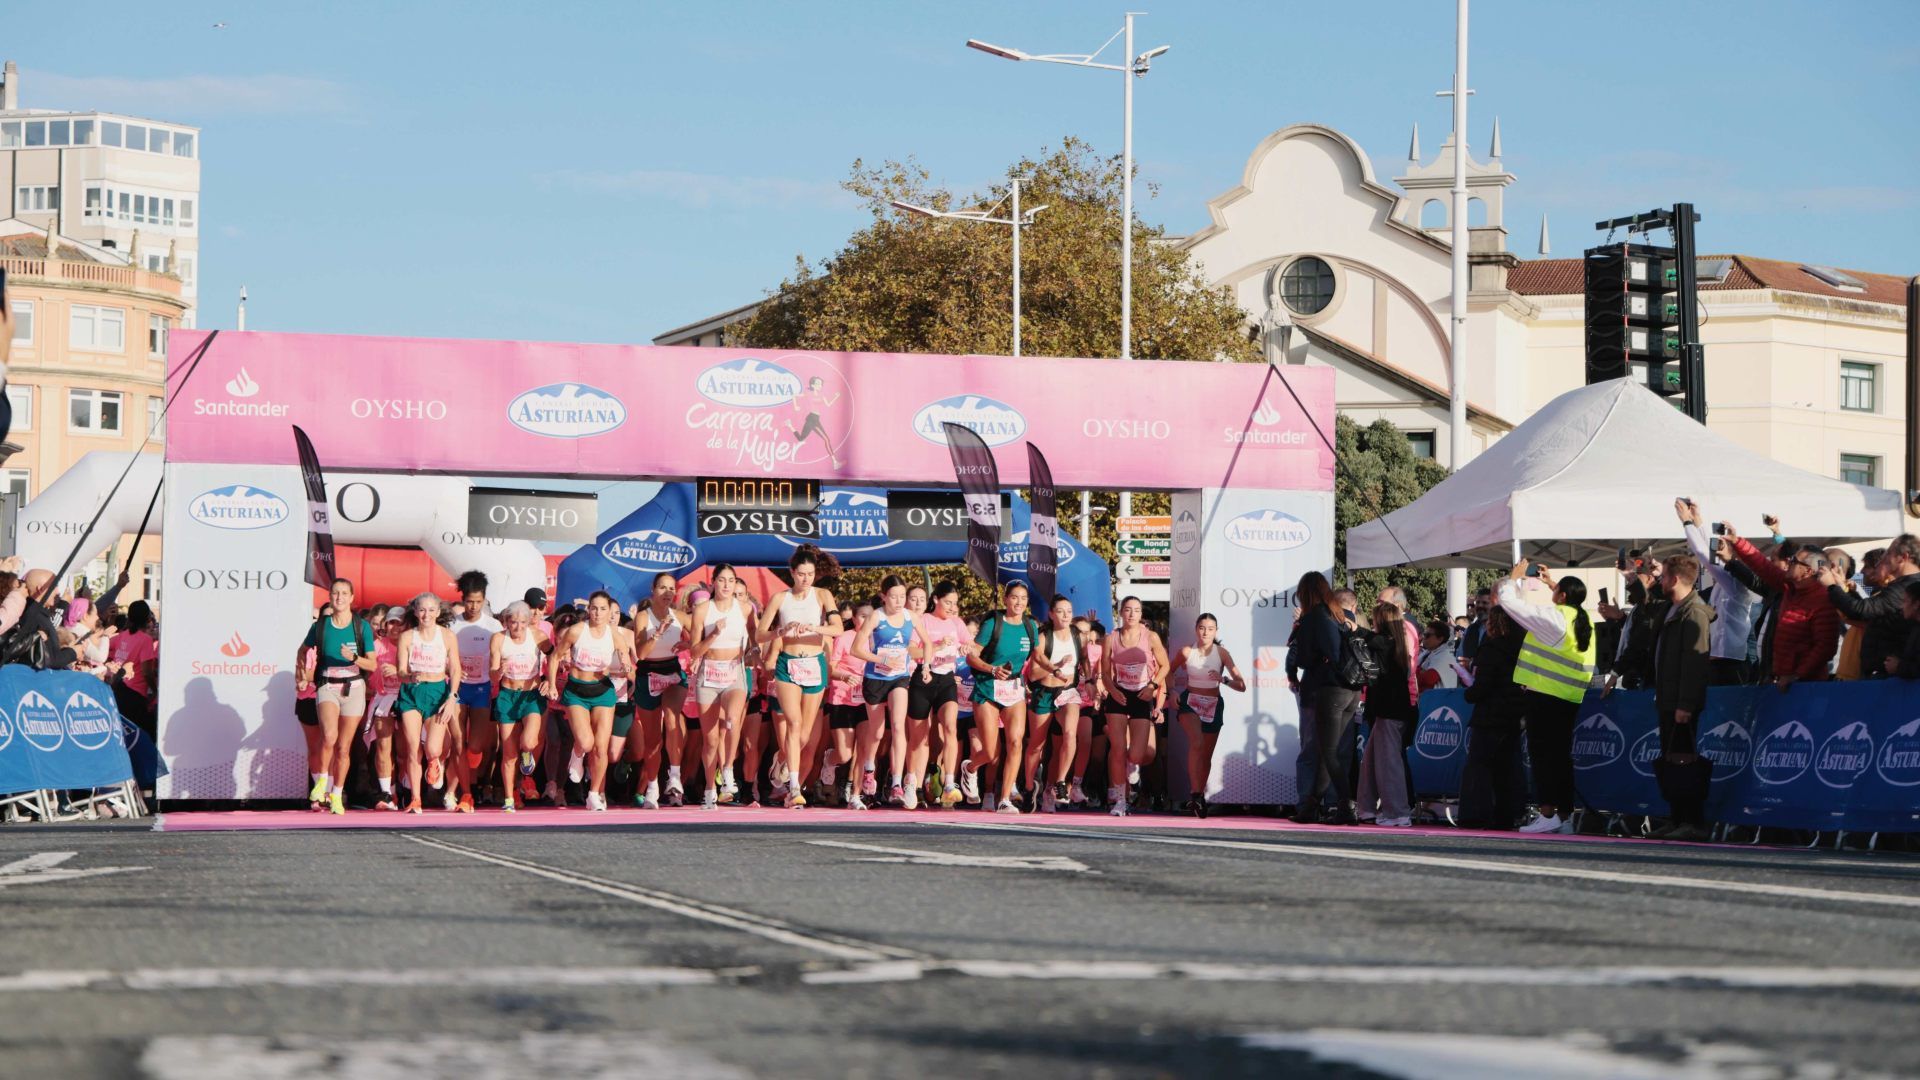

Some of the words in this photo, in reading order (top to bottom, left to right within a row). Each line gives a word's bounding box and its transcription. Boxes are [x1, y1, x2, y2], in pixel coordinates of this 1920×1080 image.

[704, 375, 794, 396] ASTURIANA
[194, 399, 290, 417] Santander
[351, 398, 447, 420] OYSHO
[517, 400, 618, 423] ASTURIANA
[686, 402, 774, 432] Carrera
[1083, 418, 1171, 440] OYSHO
[1223, 427, 1308, 445] Santander
[707, 431, 722, 449] de
[726, 431, 738, 450] la
[735, 429, 806, 471] Mujer
[196, 501, 281, 519] ASTURIANA
[489, 505, 579, 528] OYSHO
[854, 509, 887, 517] LECHE
[906, 508, 970, 526] OYSH
[702, 513, 814, 535] OYSHO
[1231, 524, 1305, 542] ASTURIANA
[608, 541, 689, 564] ASTURIANA
[624, 541, 656, 549] CENTRAL
[183, 569, 288, 591] OYSHO
[191, 661, 278, 676] Santander
[1417, 725, 1458, 747] ASTURIANA
